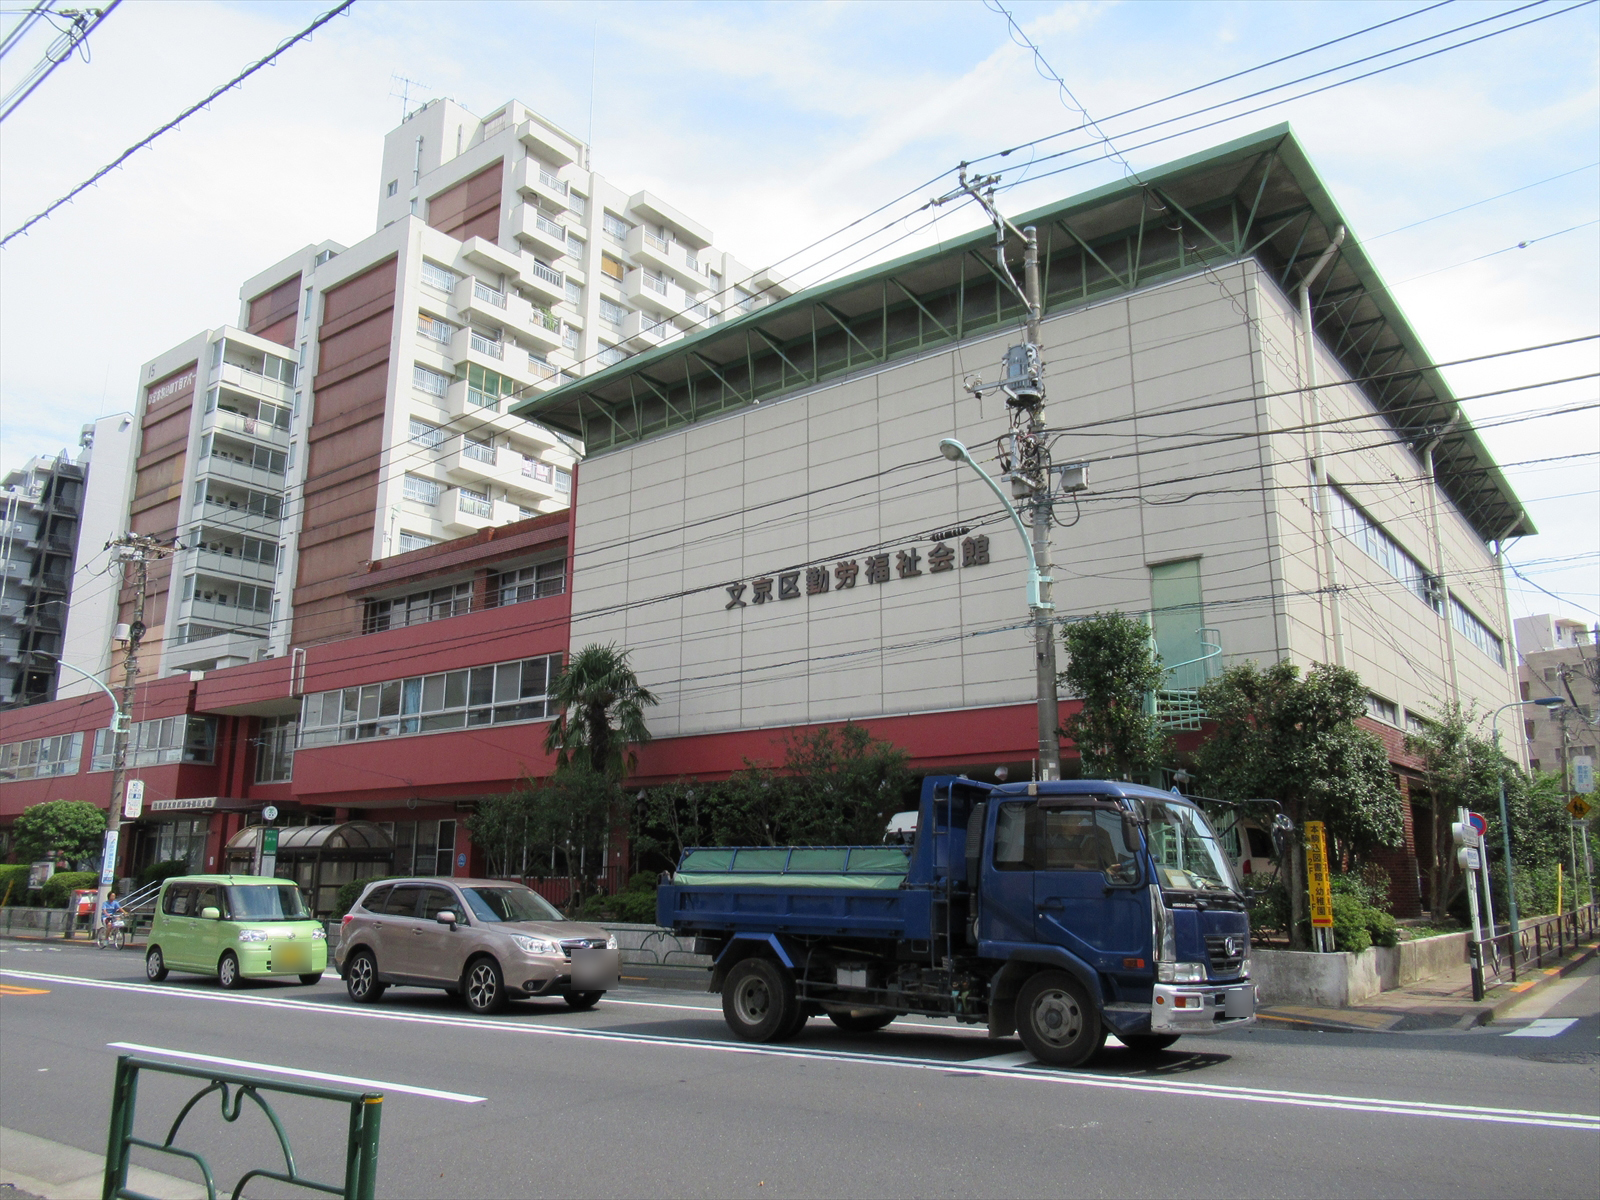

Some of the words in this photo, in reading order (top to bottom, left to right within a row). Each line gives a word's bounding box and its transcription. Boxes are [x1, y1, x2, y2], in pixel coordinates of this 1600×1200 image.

[725, 534, 991, 610] 文京区勤労福祉会館
